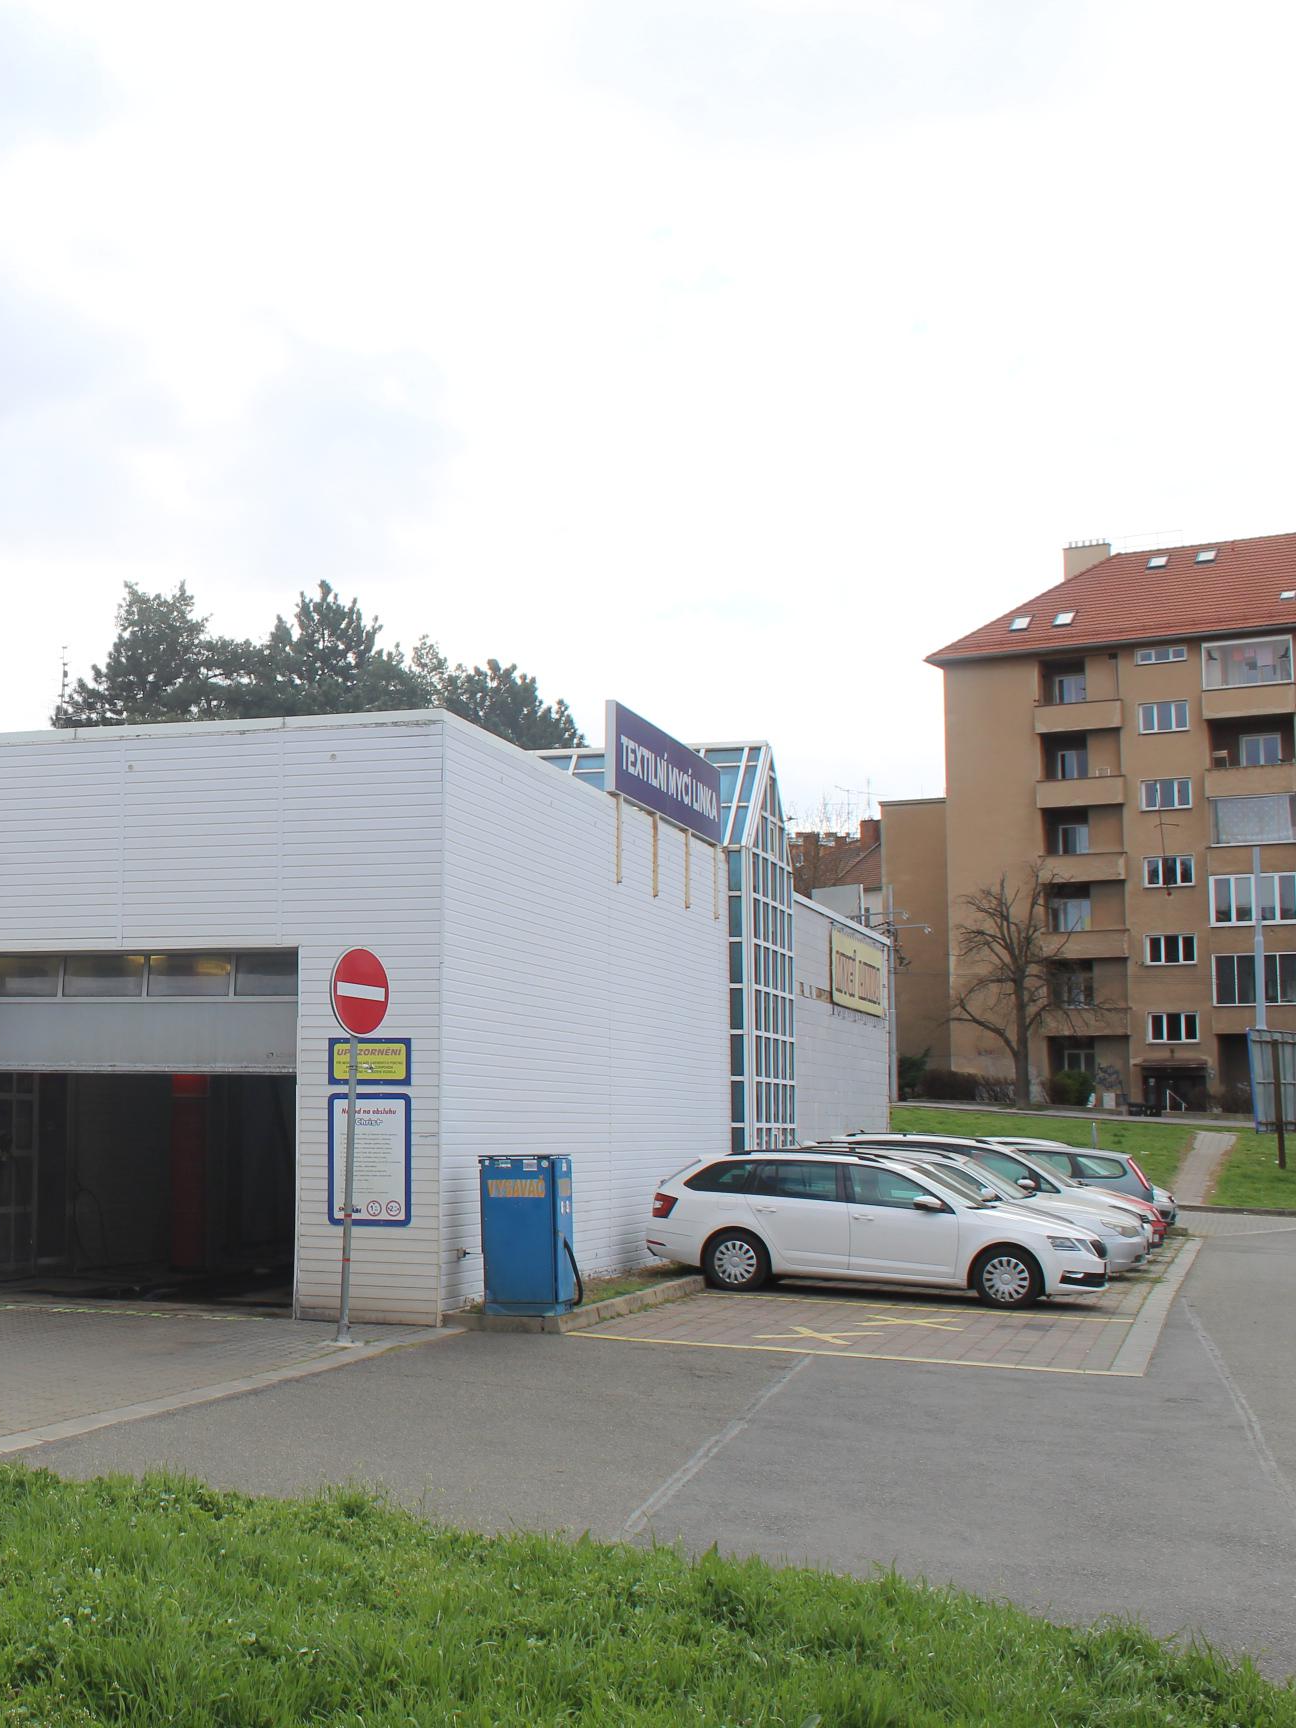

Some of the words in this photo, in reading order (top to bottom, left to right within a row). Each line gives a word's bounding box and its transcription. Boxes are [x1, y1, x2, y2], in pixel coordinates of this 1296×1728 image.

[620, 734, 668, 793] TEXTILNÍ
[668, 763, 692, 807] MYCÍ
[692, 779, 718, 822] LINKA
[336, 1046, 402, 1056] UPZORNĚNÍ
[487, 1174, 546, 1198] VYSAVAČ
